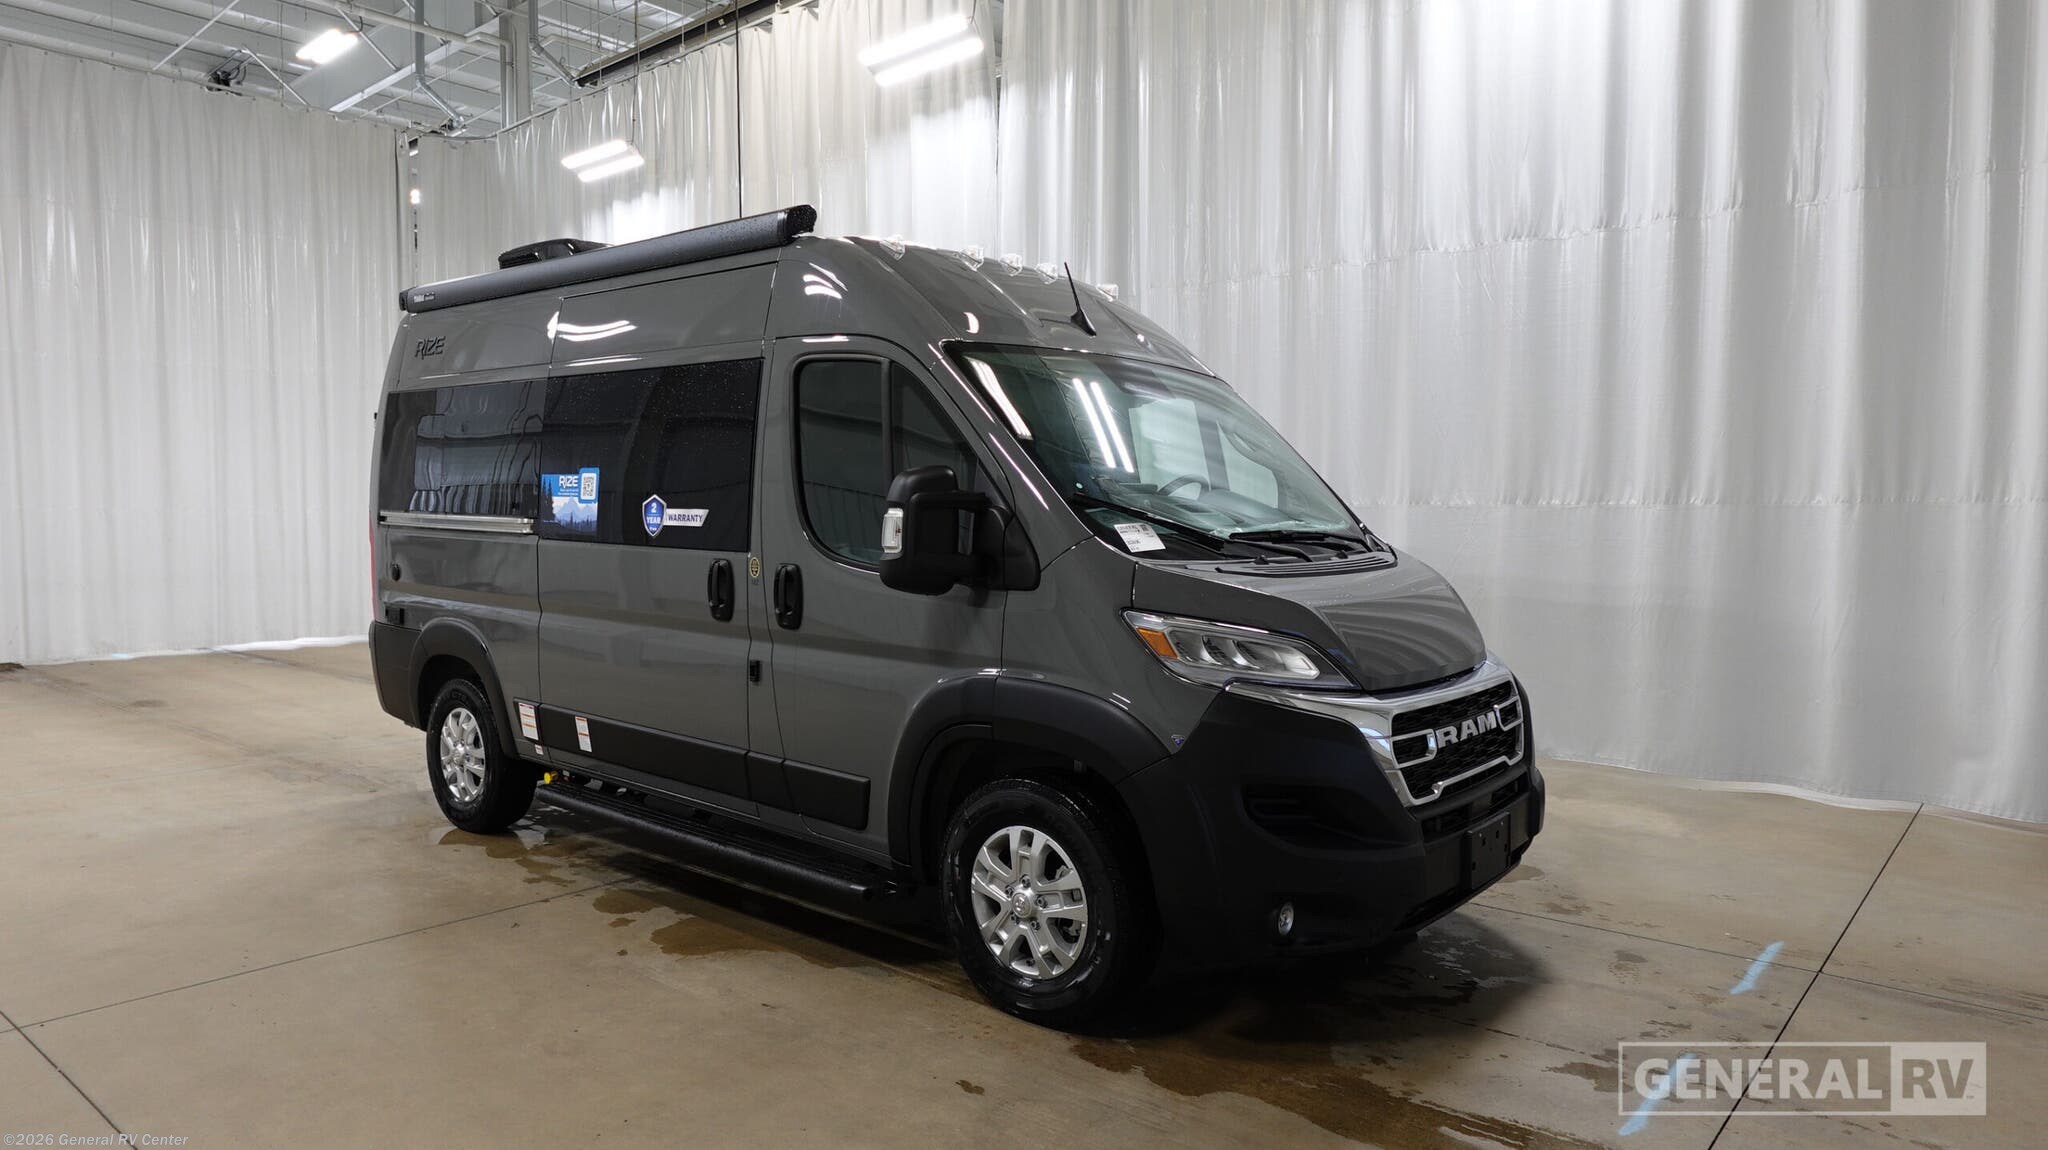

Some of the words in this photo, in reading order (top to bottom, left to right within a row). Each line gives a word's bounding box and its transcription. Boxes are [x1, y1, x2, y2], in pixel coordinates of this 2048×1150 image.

[414, 336, 447, 361] RIZE
[559, 475, 579, 489] RIZE
[651, 502, 658, 513] 2
[646, 516, 661, 525] YEAR
[667, 514, 704, 523] WARRANTY
[1436, 710, 1497, 749] RAM
